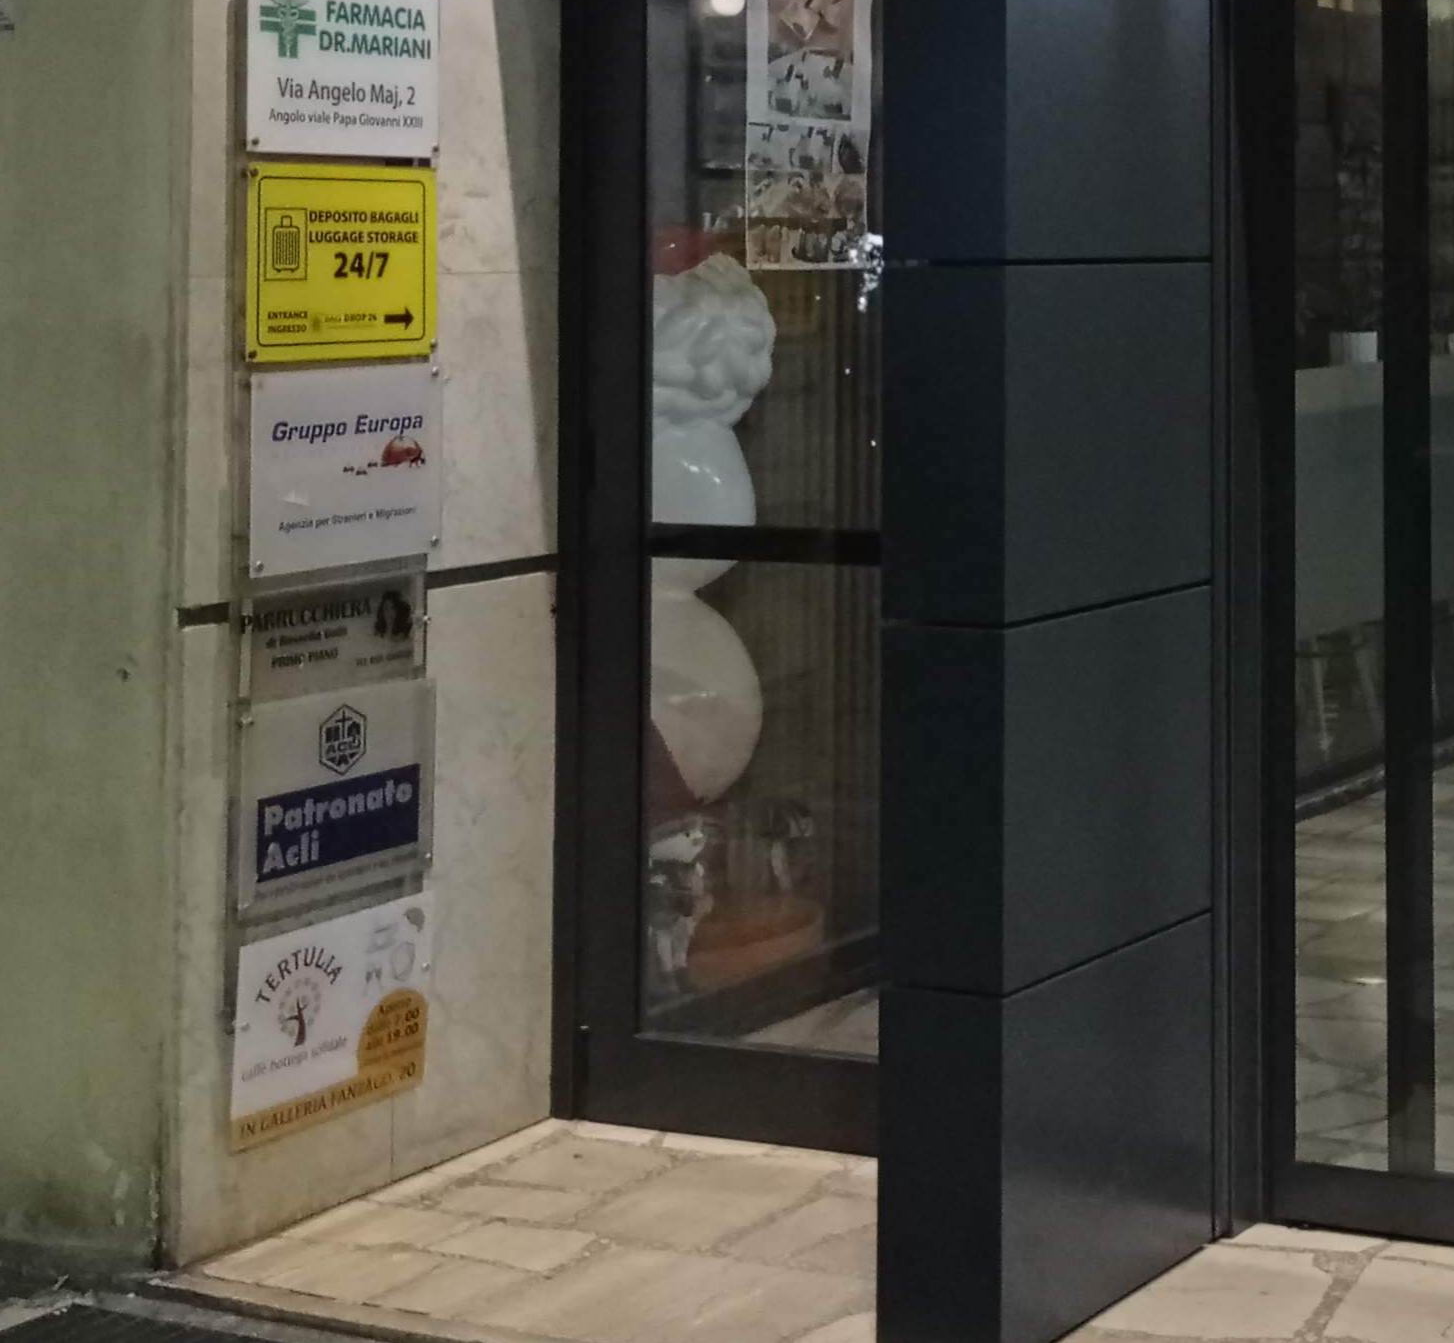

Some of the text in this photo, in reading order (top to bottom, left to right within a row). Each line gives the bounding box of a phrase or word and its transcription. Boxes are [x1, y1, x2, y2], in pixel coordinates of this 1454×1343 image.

[326, 0, 426, 32] FARMACIA
[318, 30, 431, 59] DR.MARIANI
[277, 76, 416, 109] Via Angelo Maj, 2
[269, 108, 306, 125] Angolo
[308, 110, 332, 124] viale
[333, 111, 357, 127] Papa
[359, 113, 401, 128] Giovanni
[309, 210, 419, 224] DEPOSITO BAGAGLI
[309, 231, 418, 243] LUGGAGE STORAGE
[333, 251, 390, 279] 24/7
[267, 311, 308, 320] ENTRANCE
[272, 414, 424, 444] Gruppo Europa
[278, 517, 313, 533] Agenzia
[315, 517, 329, 529] per
[263, 779, 414, 836] Patronato
[262, 829, 320, 874] Acli
[254, 945, 343, 1003] TERTULIA
[239, 1122, 256, 1138] IN
